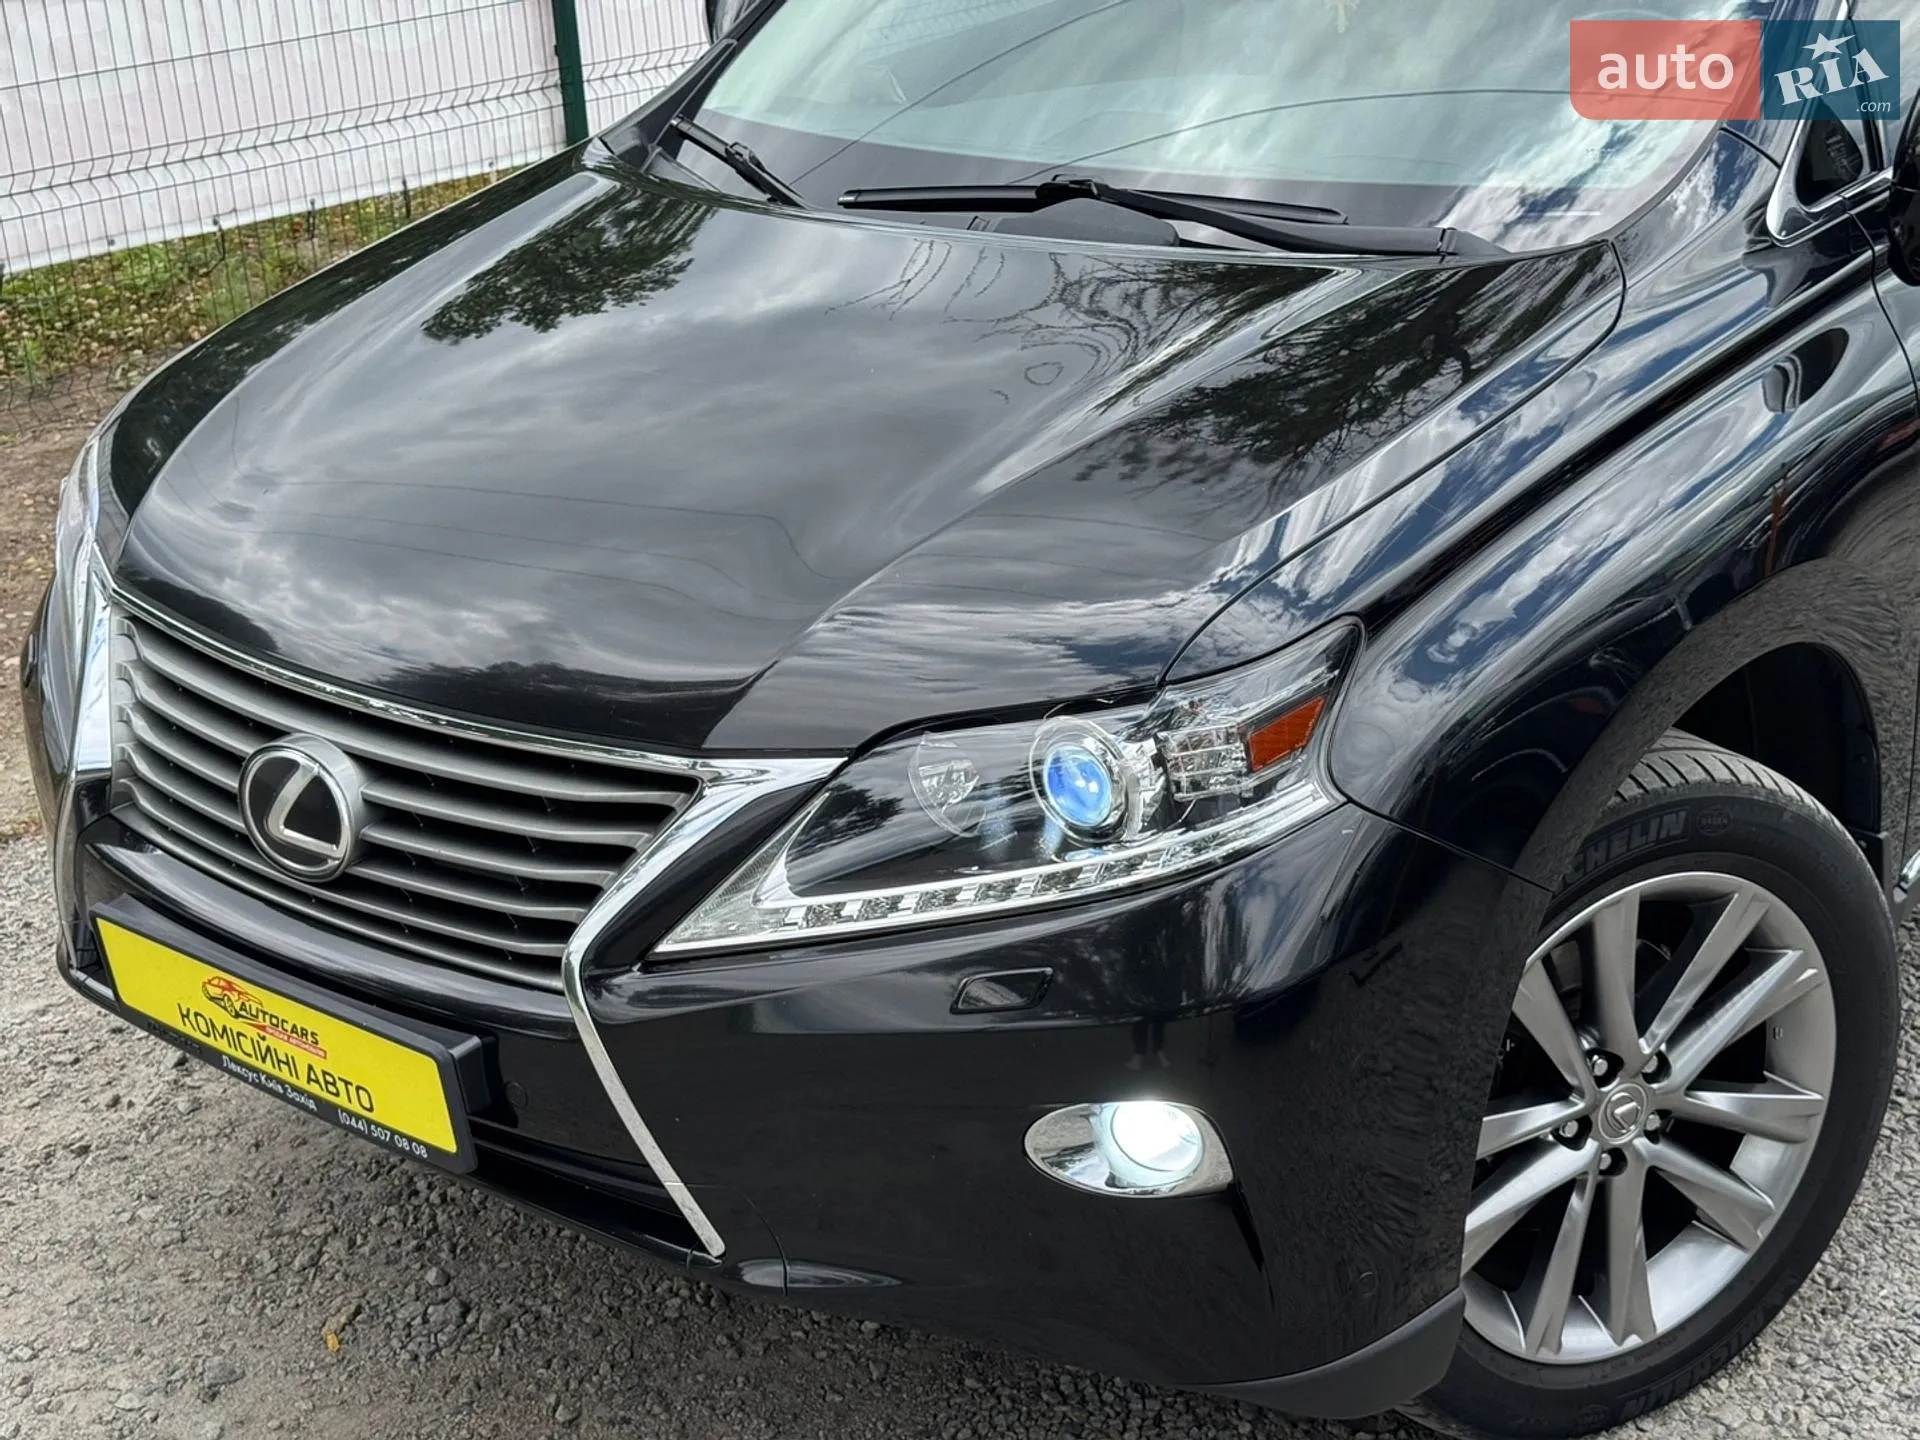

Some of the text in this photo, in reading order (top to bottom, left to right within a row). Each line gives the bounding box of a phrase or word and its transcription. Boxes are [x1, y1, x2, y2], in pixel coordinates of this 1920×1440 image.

[1563, 809, 1689, 883] CHELIN
[239, 1002, 319, 1046] AUTOCARS
[178, 1003, 300, 1081] КОМІСІЙНІ
[306, 1063, 375, 1113] АВТО
[338, 1108, 428, 1159] (044) 507 08 08
